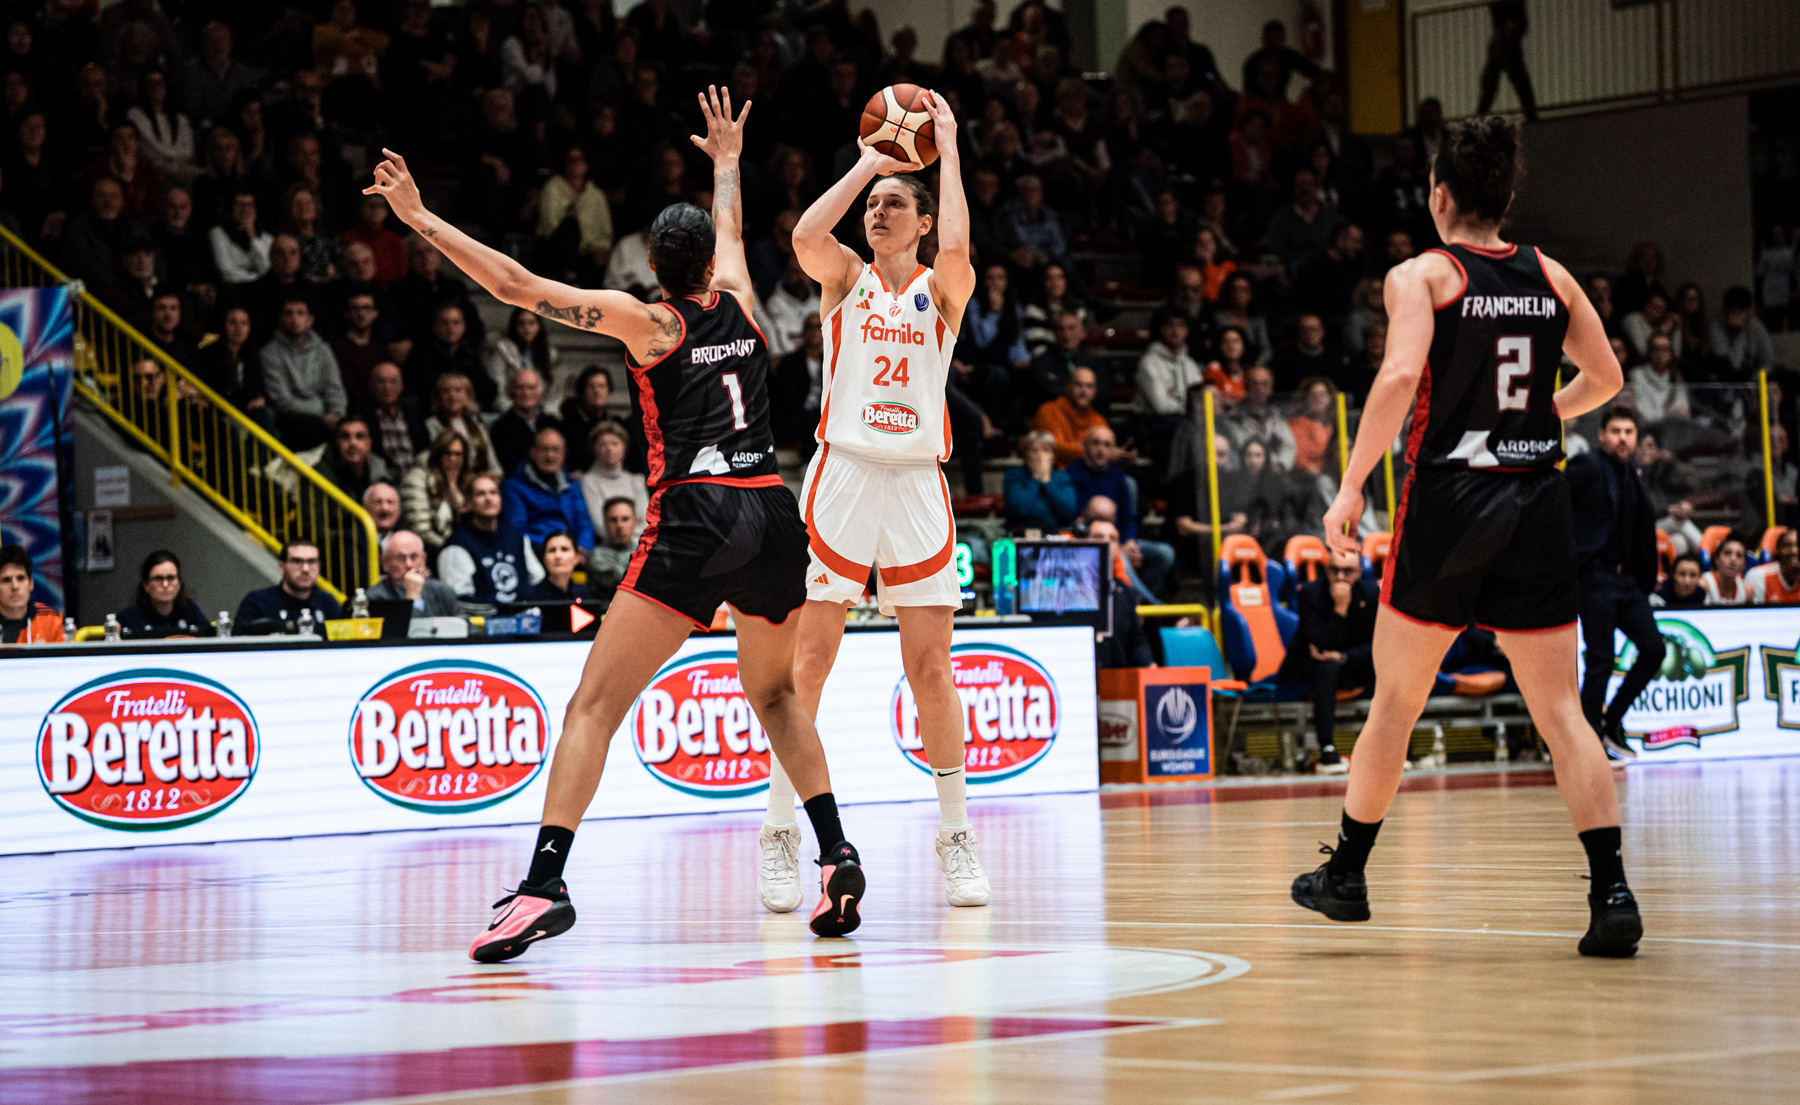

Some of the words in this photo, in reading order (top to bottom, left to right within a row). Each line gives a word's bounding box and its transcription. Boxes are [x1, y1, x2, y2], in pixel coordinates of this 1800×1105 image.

[1461, 296, 1556, 319] FRANCHELIN
[861, 314, 925, 346] famila
[873, 356, 910, 387] 24
[1496, 334, 1534, 413] 2
[721, 371, 749, 431] 1
[864, 405, 917, 429] Beretta
[410, 679, 485, 707] Fratelli
[687, 669, 744, 696] Frate
[105, 690, 187, 719] Fratelli
[358, 695, 543, 779] Beretta
[640, 689, 773, 765] Beret
[48, 706, 252, 795] Beretta
[963, 746, 1002, 767] 812
[426, 772, 479, 795] 1812
[703, 758, 751, 781] 1812
[123, 787, 181, 812] 1812
